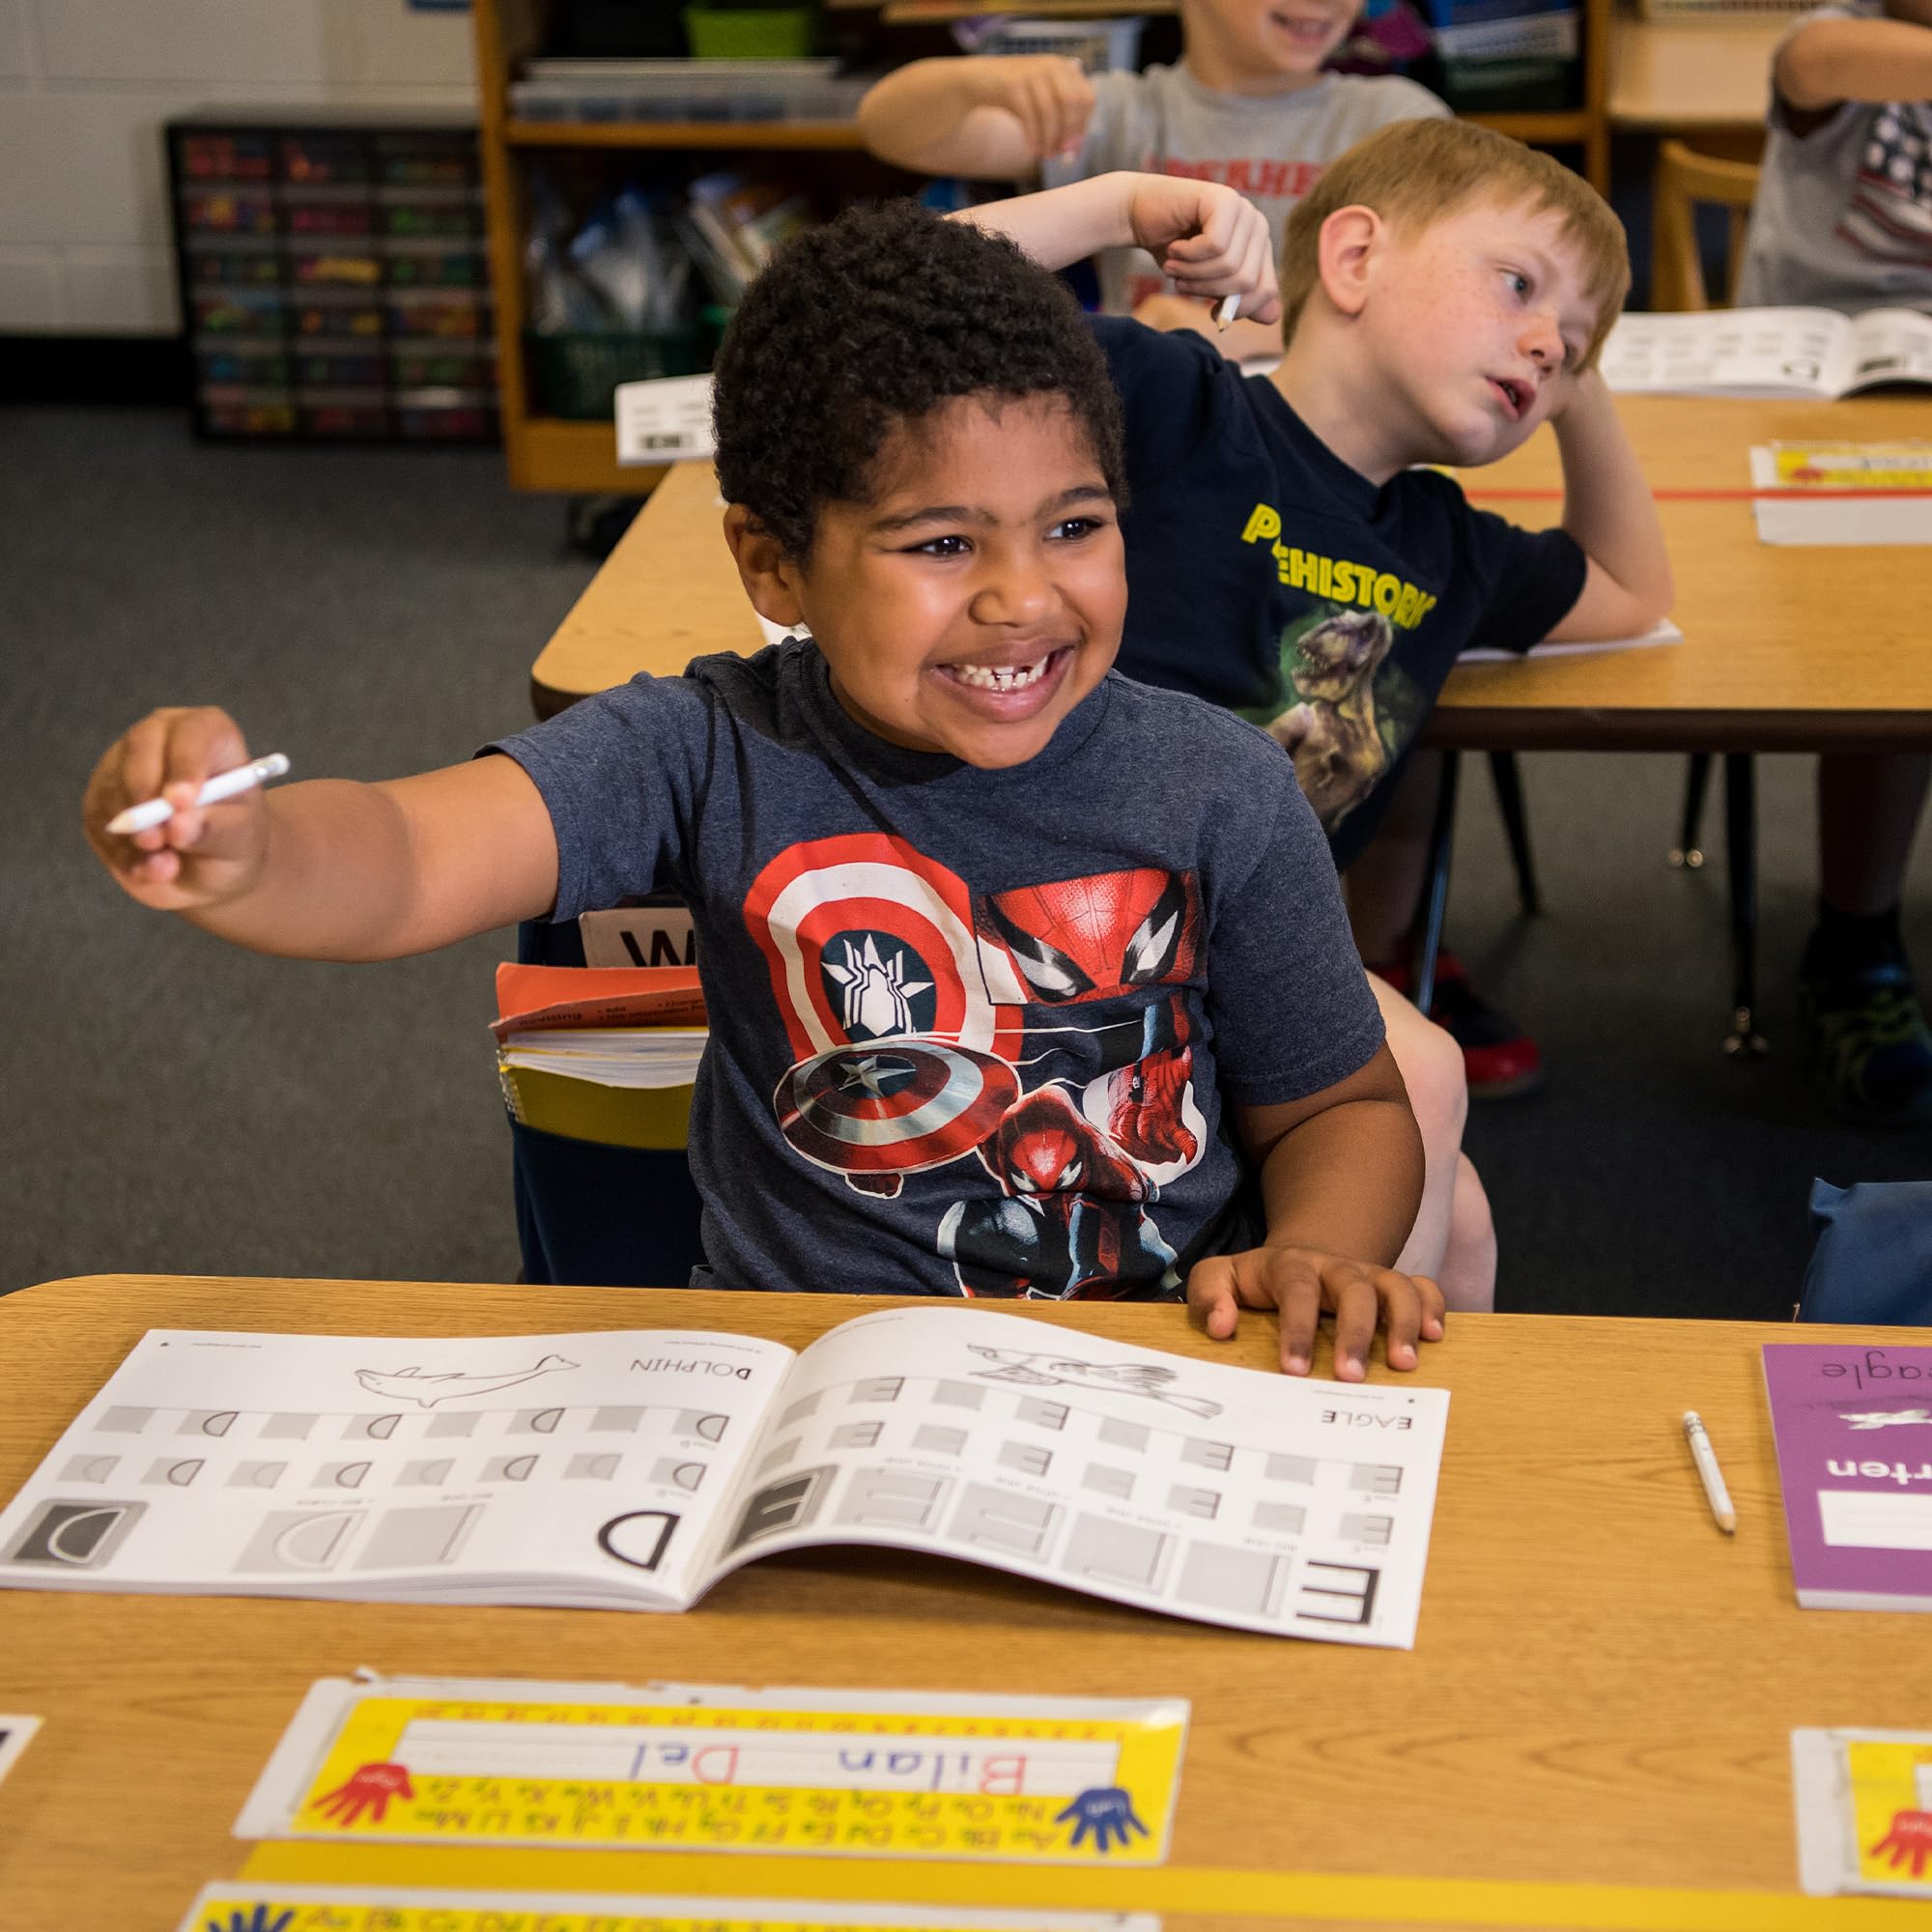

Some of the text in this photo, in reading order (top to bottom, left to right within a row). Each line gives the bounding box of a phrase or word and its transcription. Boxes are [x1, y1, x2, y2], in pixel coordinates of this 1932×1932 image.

[630, 1358, 752, 1380] DOLPHIN
[1321, 1409, 1412, 1431] EAGLE
[597, 1511, 680, 1572] D
[1295, 1561, 1380, 1627] E
[629, 1743, 1028, 1796] Bilan Del
